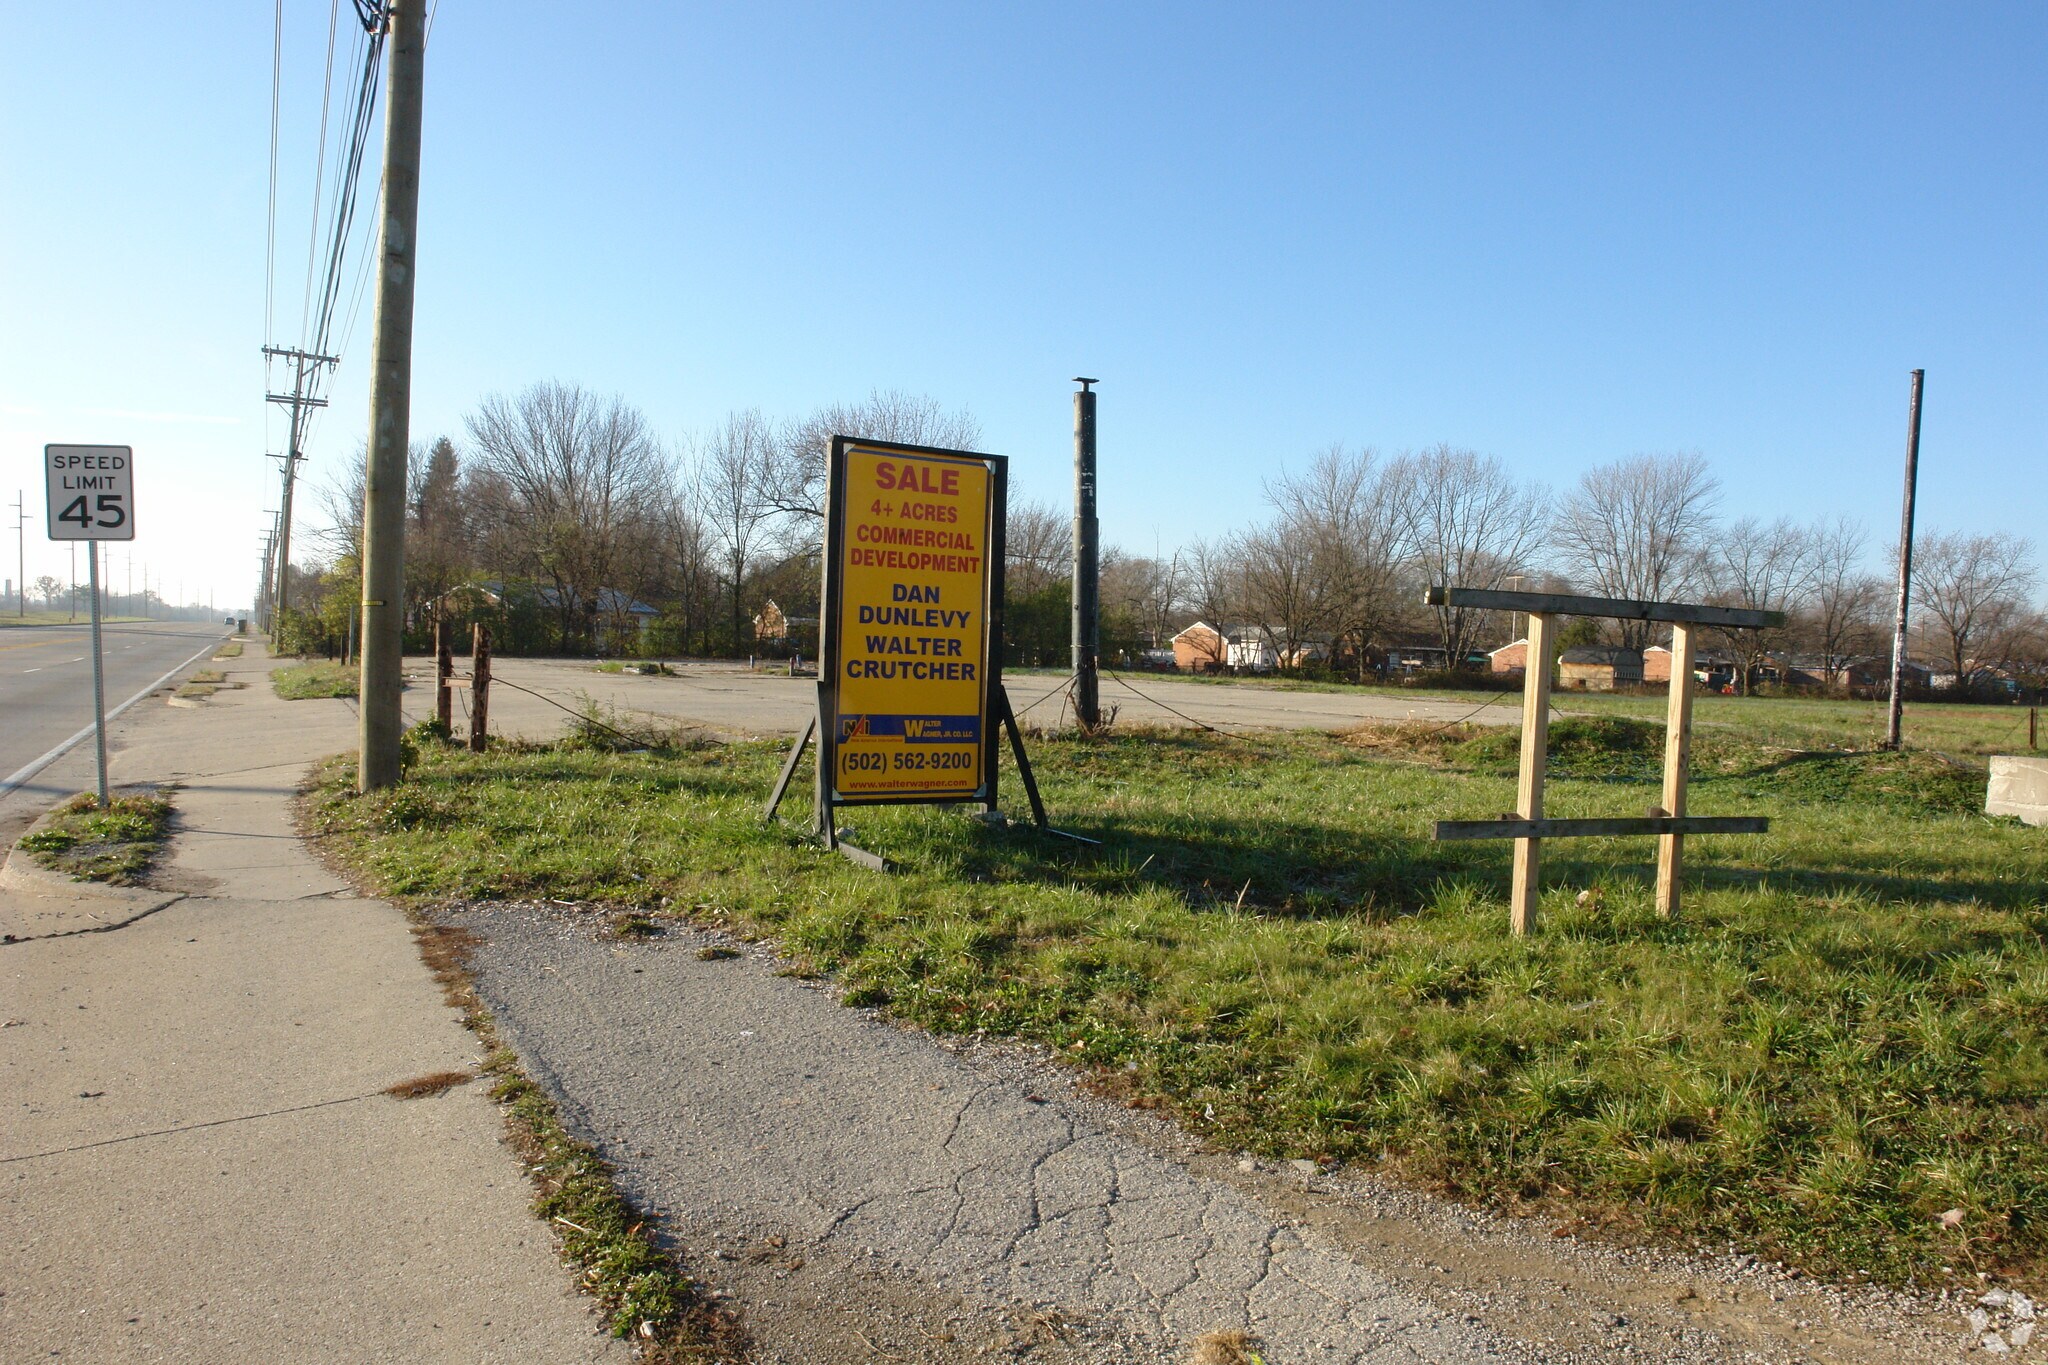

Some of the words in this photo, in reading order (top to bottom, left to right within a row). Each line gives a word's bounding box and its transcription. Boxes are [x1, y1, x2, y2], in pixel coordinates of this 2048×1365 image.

[53, 455, 125, 470] SPEED
[63, 475, 116, 490] LIMIT
[875, 461, 960, 496] SALE
[58, 494, 126, 529] 45
[870, 498, 894, 518] 4+
[899, 501, 958, 524] ACRES
[856, 523, 975, 551] COMMERCIAL
[850, 547, 980, 574] DEVELOPMENT
[892, 583, 940, 604] DAN
[858, 605, 971, 629] DUNLEVY
[865, 635, 962, 657] WALTER
[846, 659, 976, 681] CRUTCHER
[841, 752, 888, 775] (502)
[893, 751, 972, 770] 562-9200
[849, 779, 968, 790] www.walterwagner.com
